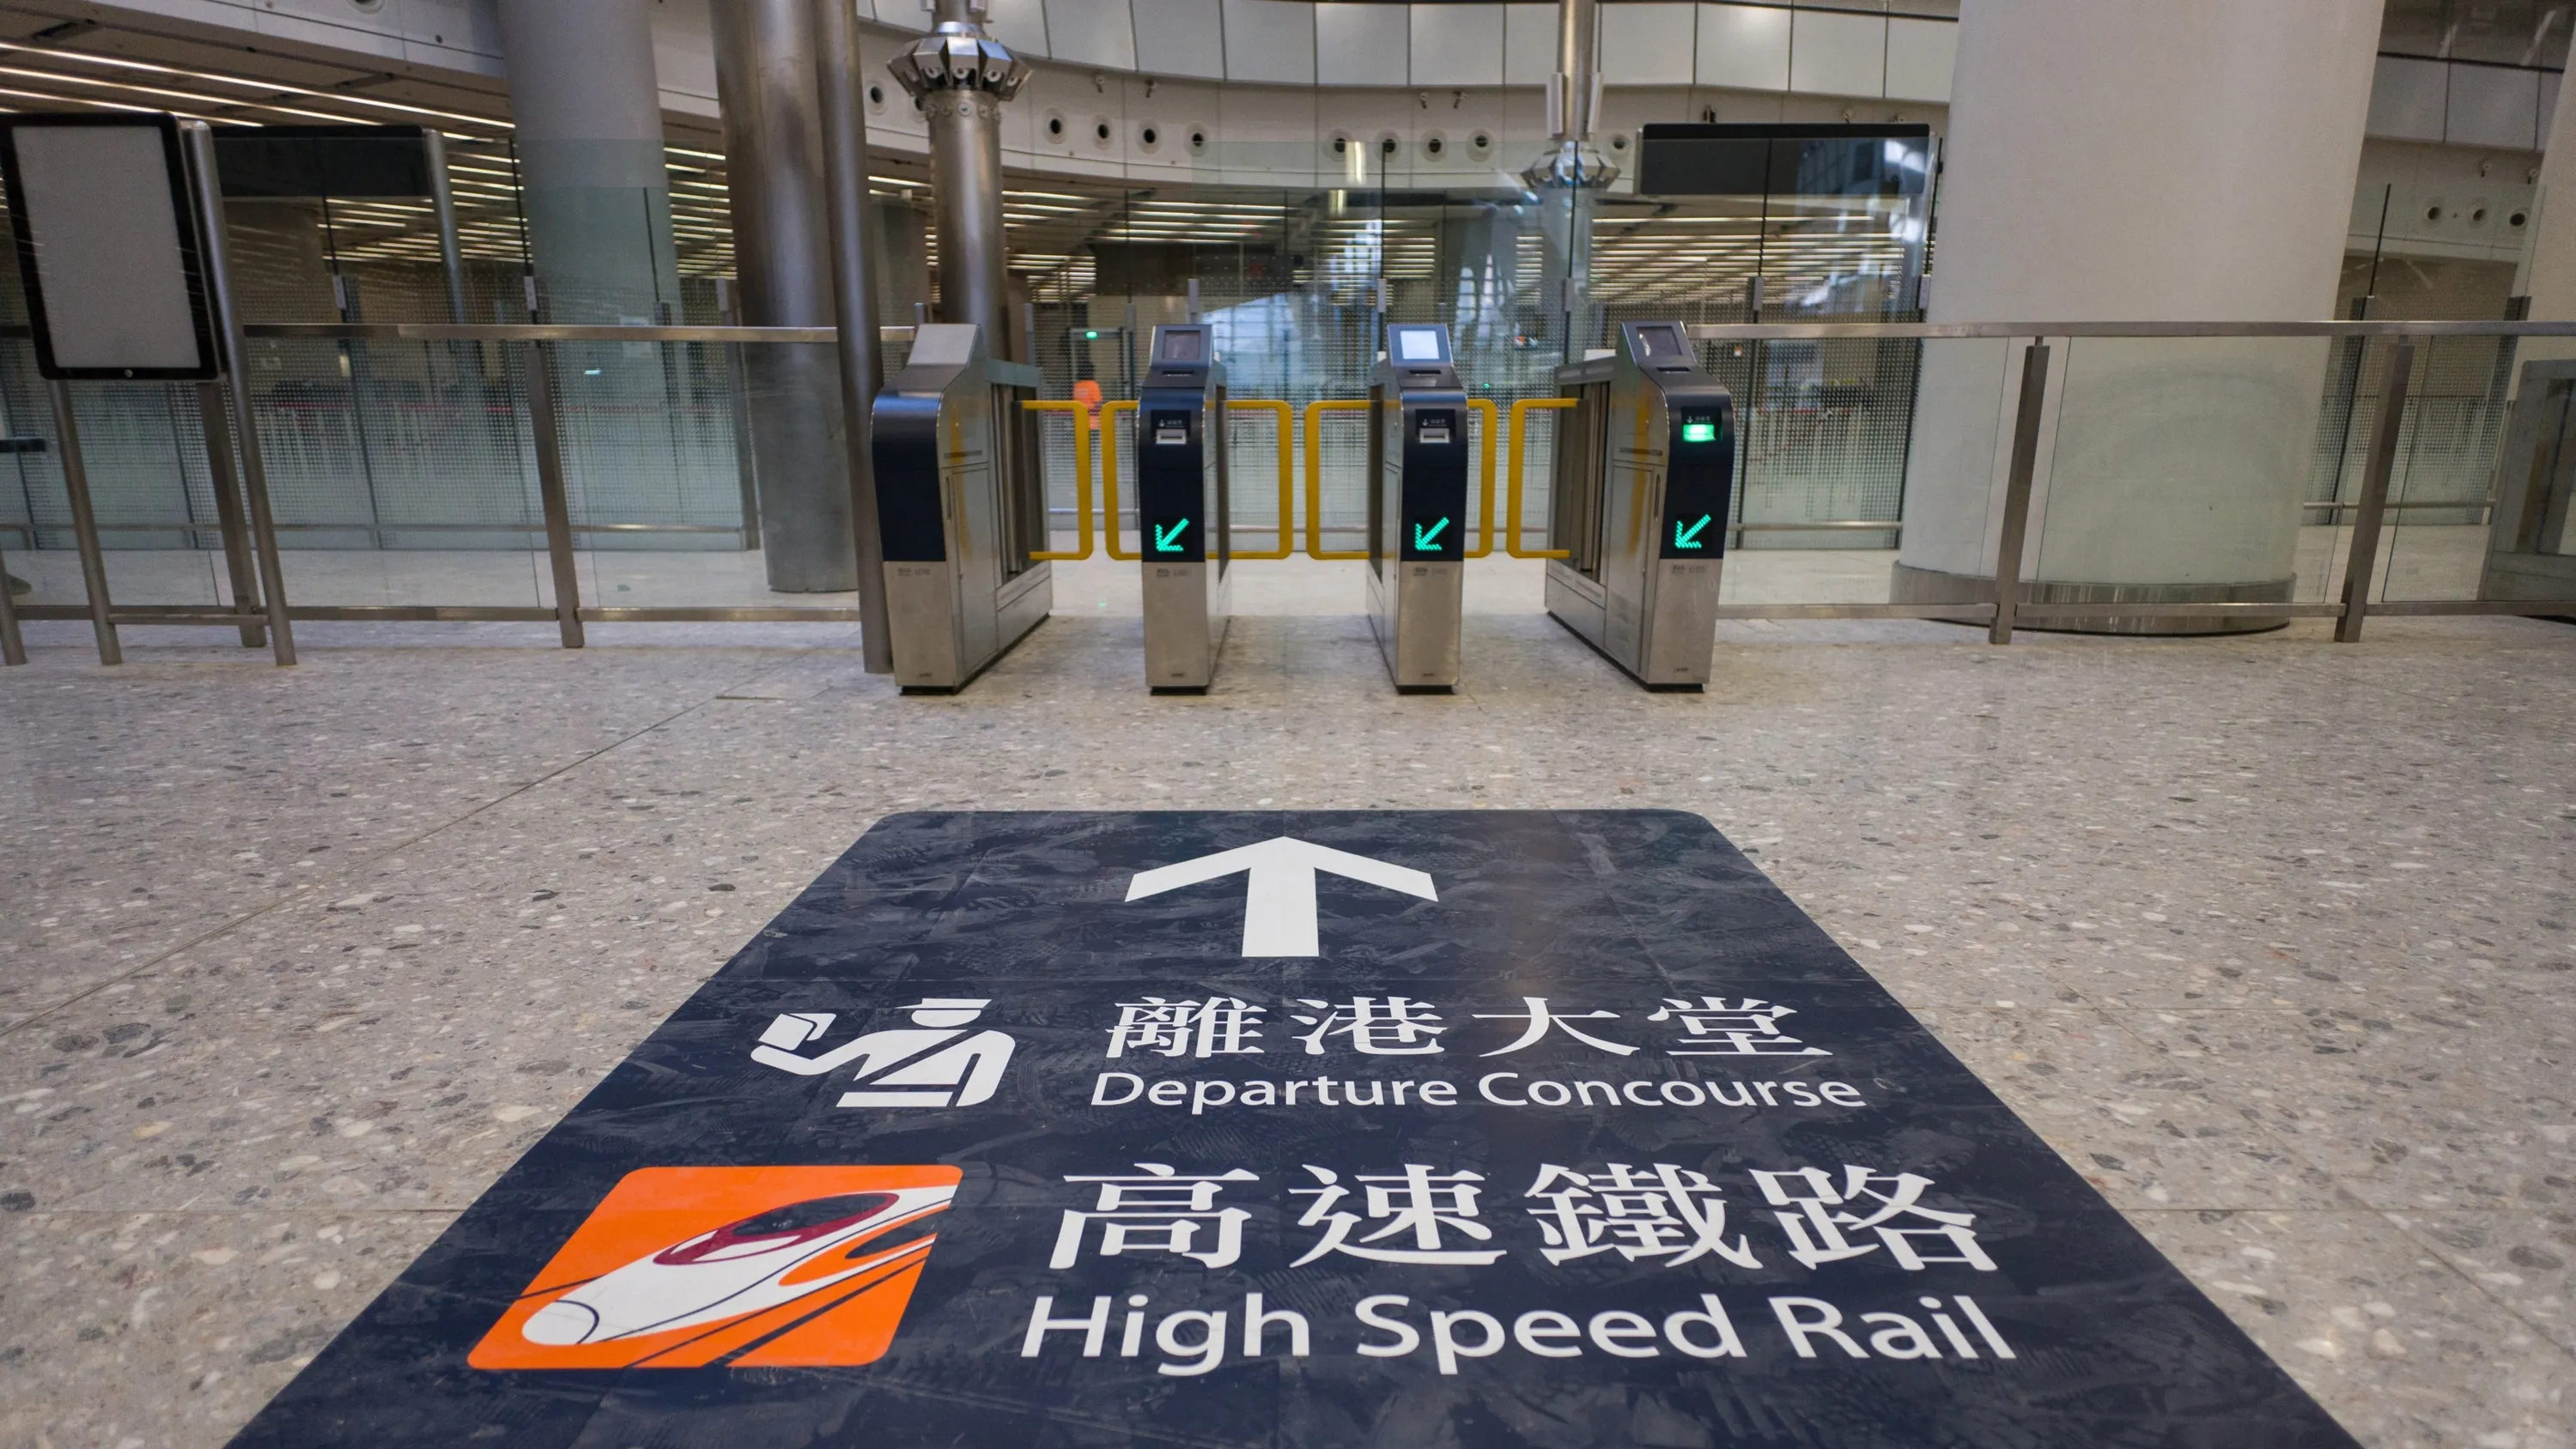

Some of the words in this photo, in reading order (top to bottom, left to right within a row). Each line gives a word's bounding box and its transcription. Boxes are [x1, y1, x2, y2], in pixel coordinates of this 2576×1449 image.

[1106, 996, 1832, 1058] 離港大堂
[1091, 1071, 1457, 1116] Departure
[1479, 1071, 1866, 1108] Concourse
[1049, 1162, 1997, 1271] 高速鐵路
[1022, 1293, 1310, 1376] High
[1355, 1293, 1747, 1375] Speed
[1769, 1295, 2016, 1360] Rail
